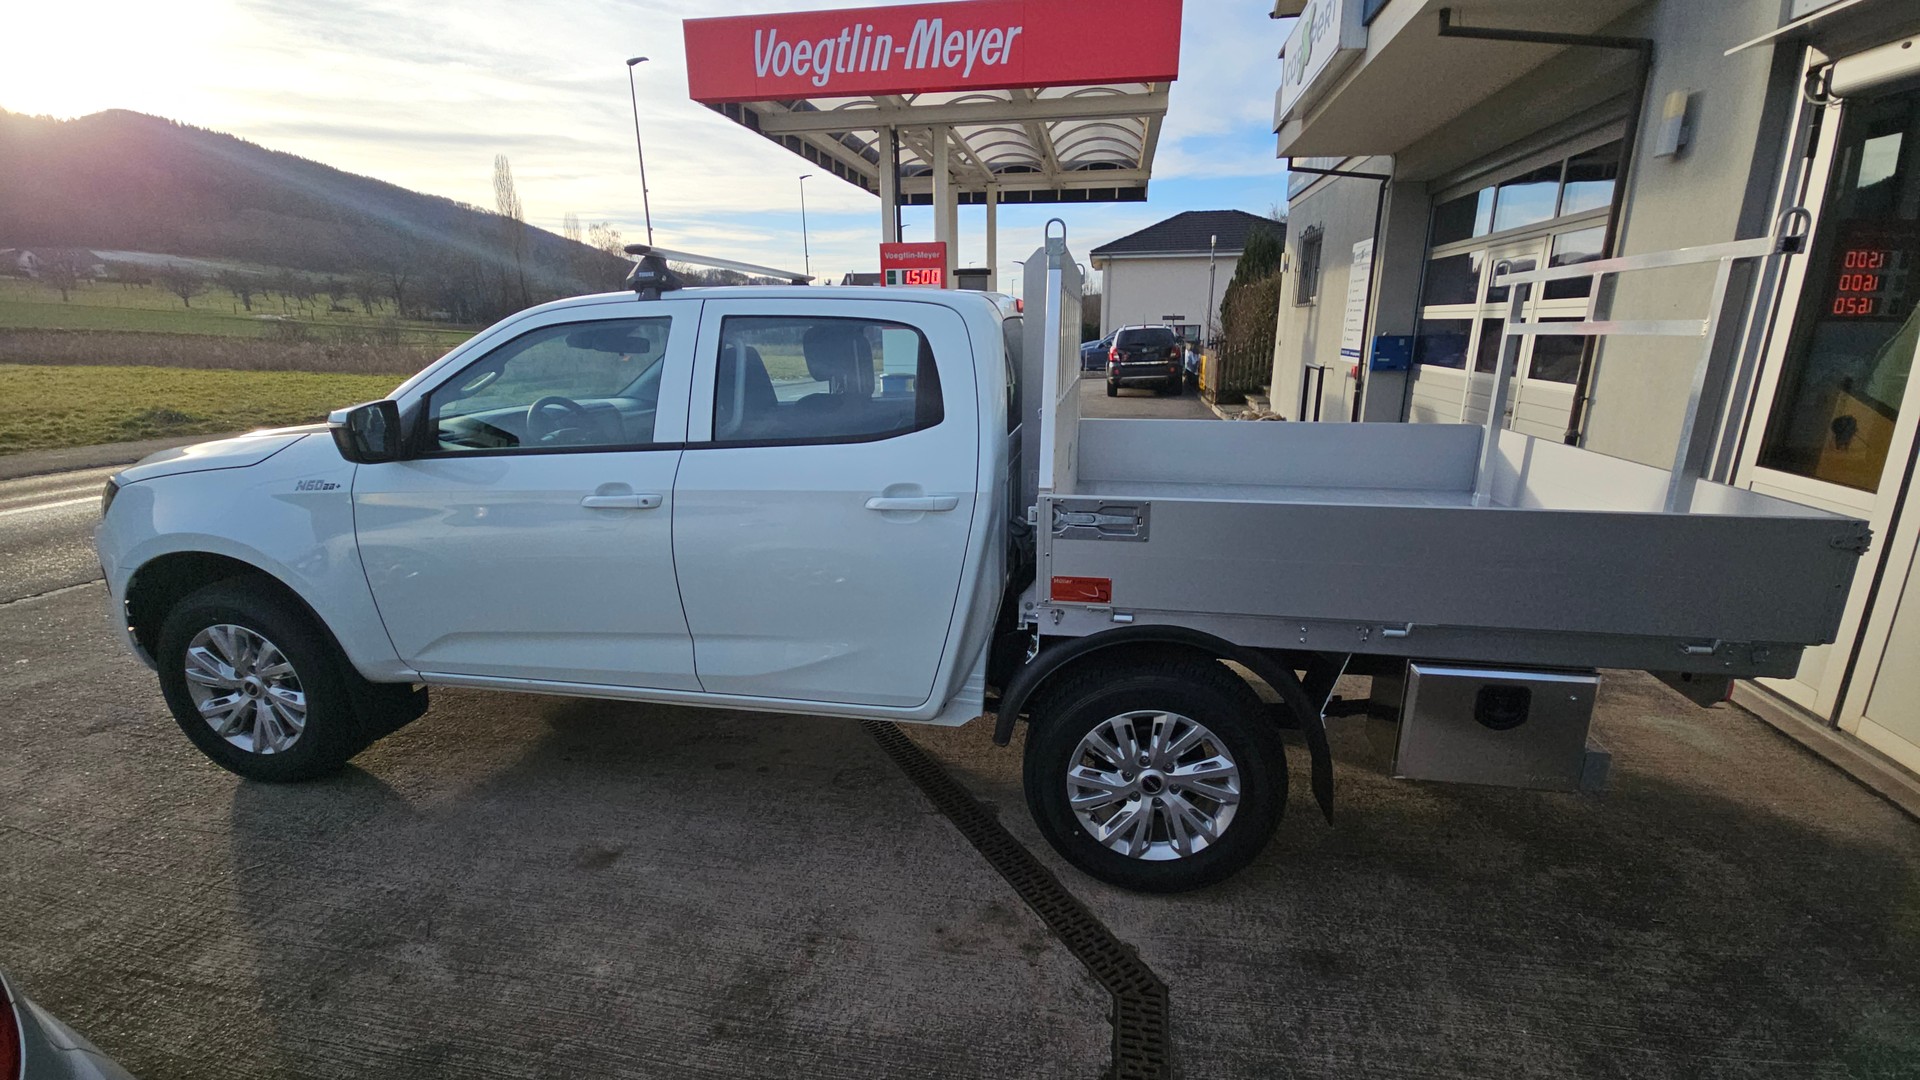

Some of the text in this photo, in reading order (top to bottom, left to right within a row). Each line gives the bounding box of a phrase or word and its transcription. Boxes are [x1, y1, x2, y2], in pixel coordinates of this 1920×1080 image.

[754, 18, 1022, 87] Voegtlin-Meyer
[885, 251, 940, 260] Voegtlin-Meyer
[906, 269, 941, 285] 1.500
